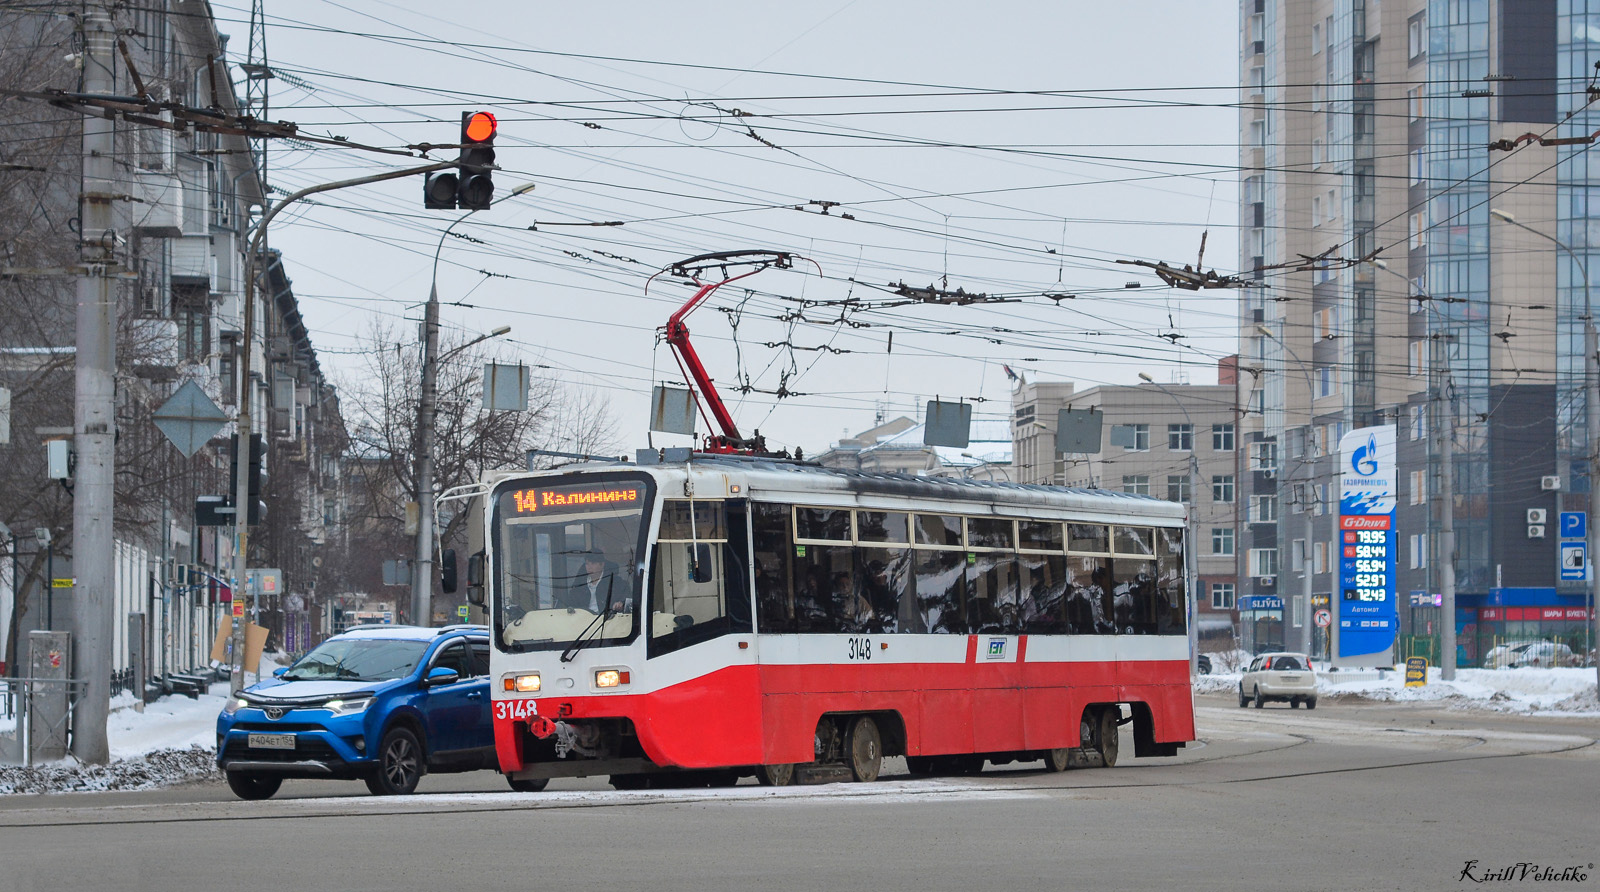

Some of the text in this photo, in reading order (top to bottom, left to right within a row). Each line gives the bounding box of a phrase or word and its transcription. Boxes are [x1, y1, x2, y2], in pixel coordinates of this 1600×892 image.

[513, 489, 637, 512] 14 Калинина
[1544, 610, 1563, 618] ШАРЫ
[848, 637, 872, 660] 3148
[495, 699, 538, 720] 3148
